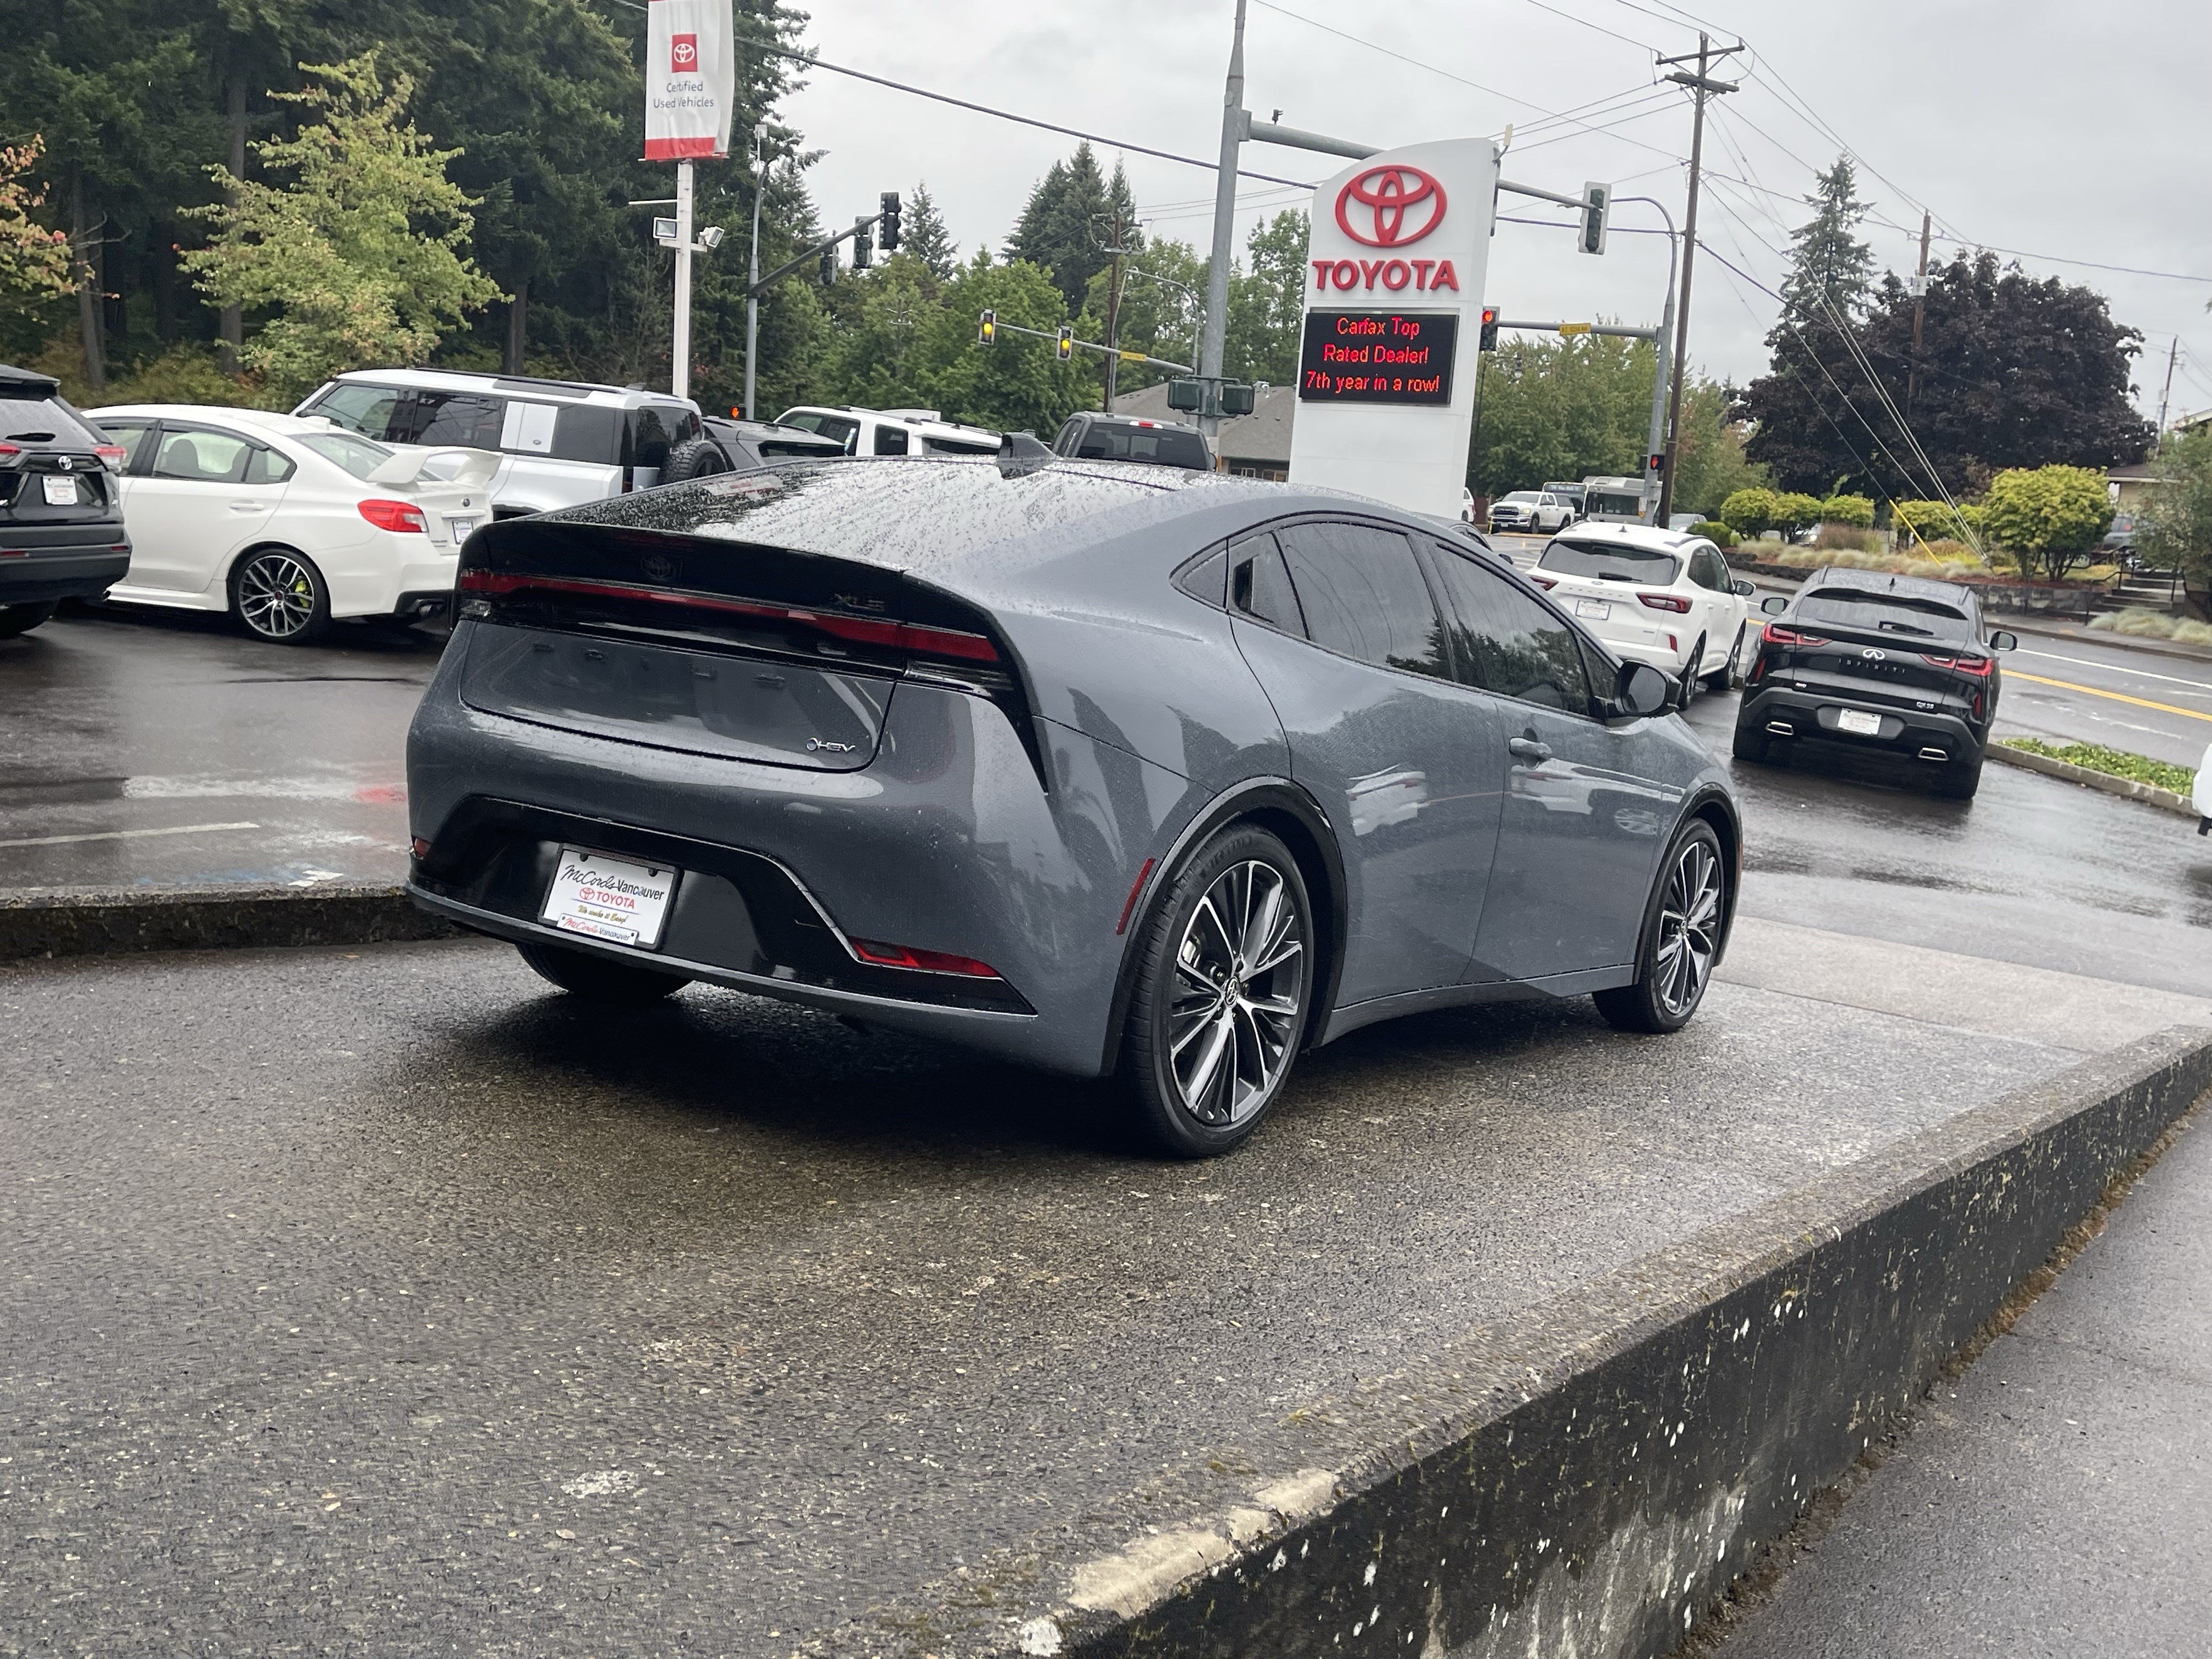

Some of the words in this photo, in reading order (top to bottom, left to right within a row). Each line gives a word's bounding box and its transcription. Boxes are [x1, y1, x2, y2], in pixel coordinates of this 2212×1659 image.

[666, 81, 703, 93] Certified
[653, 98, 675, 109] Used
[677, 97, 714, 108] Vehicles
[1312, 259, 1459, 291] TOYOTA
[1336, 316, 1386, 335] Carfax
[1391, 317, 1420, 340] Top
[1323, 343, 1369, 363] Rated
[1373, 344, 1429, 364] Dealer!
[1307, 370, 1330, 389] 7th
[1335, 376, 1370, 394] year
[1373, 373, 1387, 391] in
[1392, 377, 1403, 391] a
[1408, 374, 1440, 392] row!
[597, 891, 635, 909] TOYOTA
